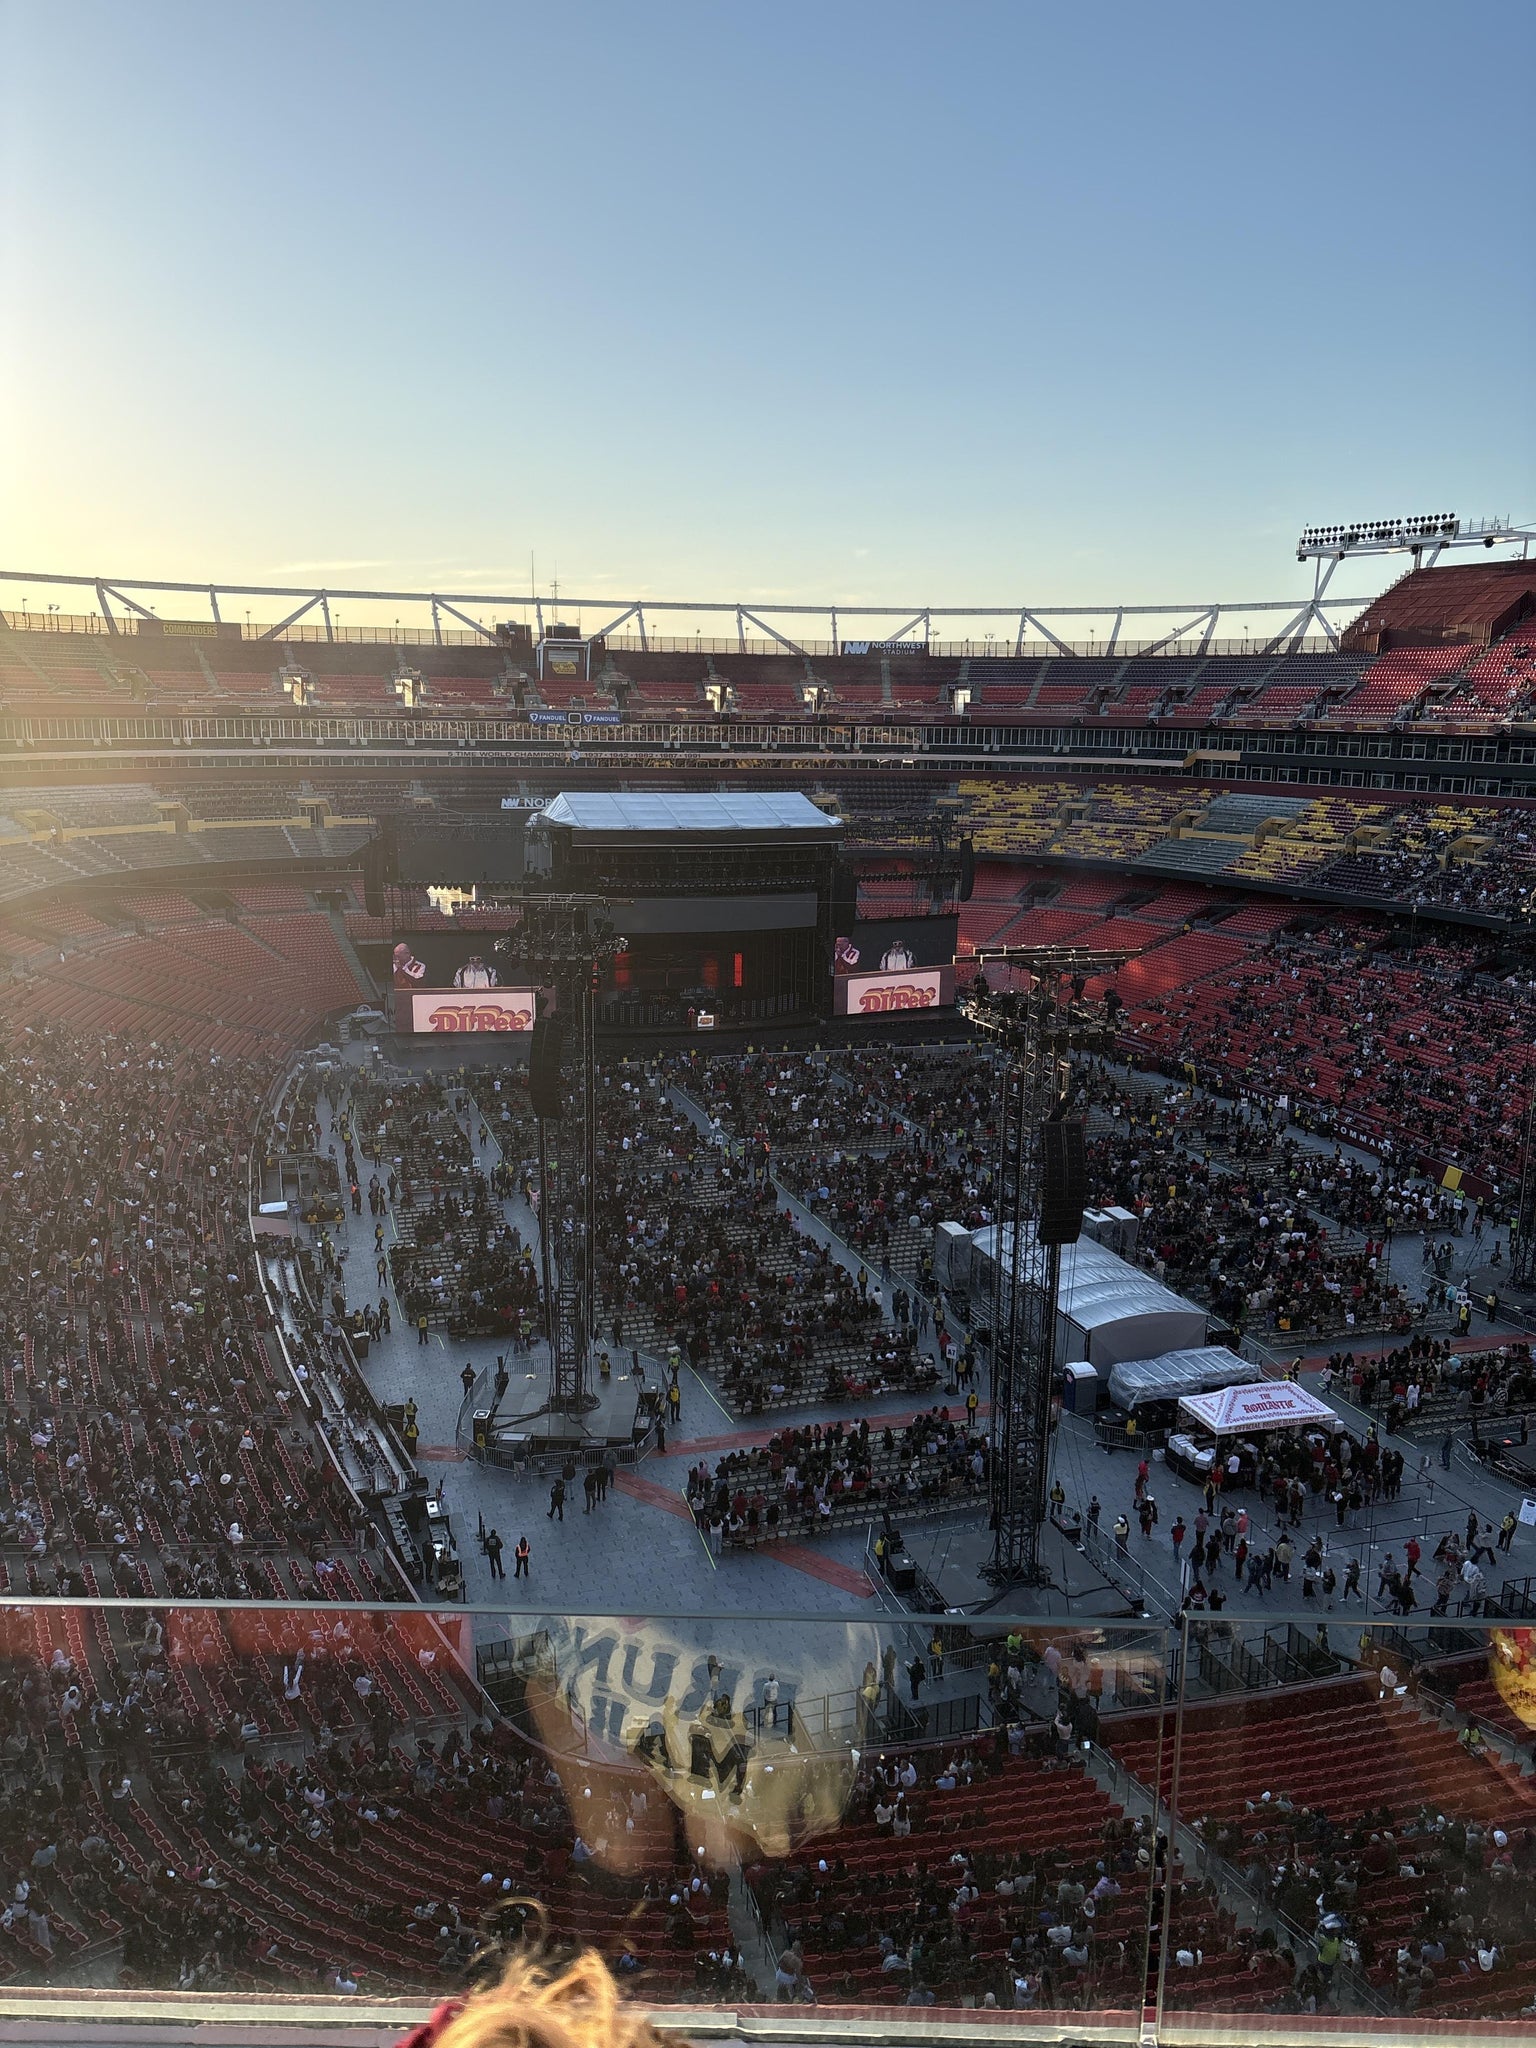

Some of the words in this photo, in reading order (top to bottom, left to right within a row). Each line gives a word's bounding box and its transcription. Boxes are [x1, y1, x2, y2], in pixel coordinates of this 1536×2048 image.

[163, 624, 218, 636] COMMANDERS
[1333, 1123, 1384, 1150] COMMAN
[1242, 1399, 1296, 1414] ROMANTIC
[1234, 1423, 1261, 1431] OFFICIAL
